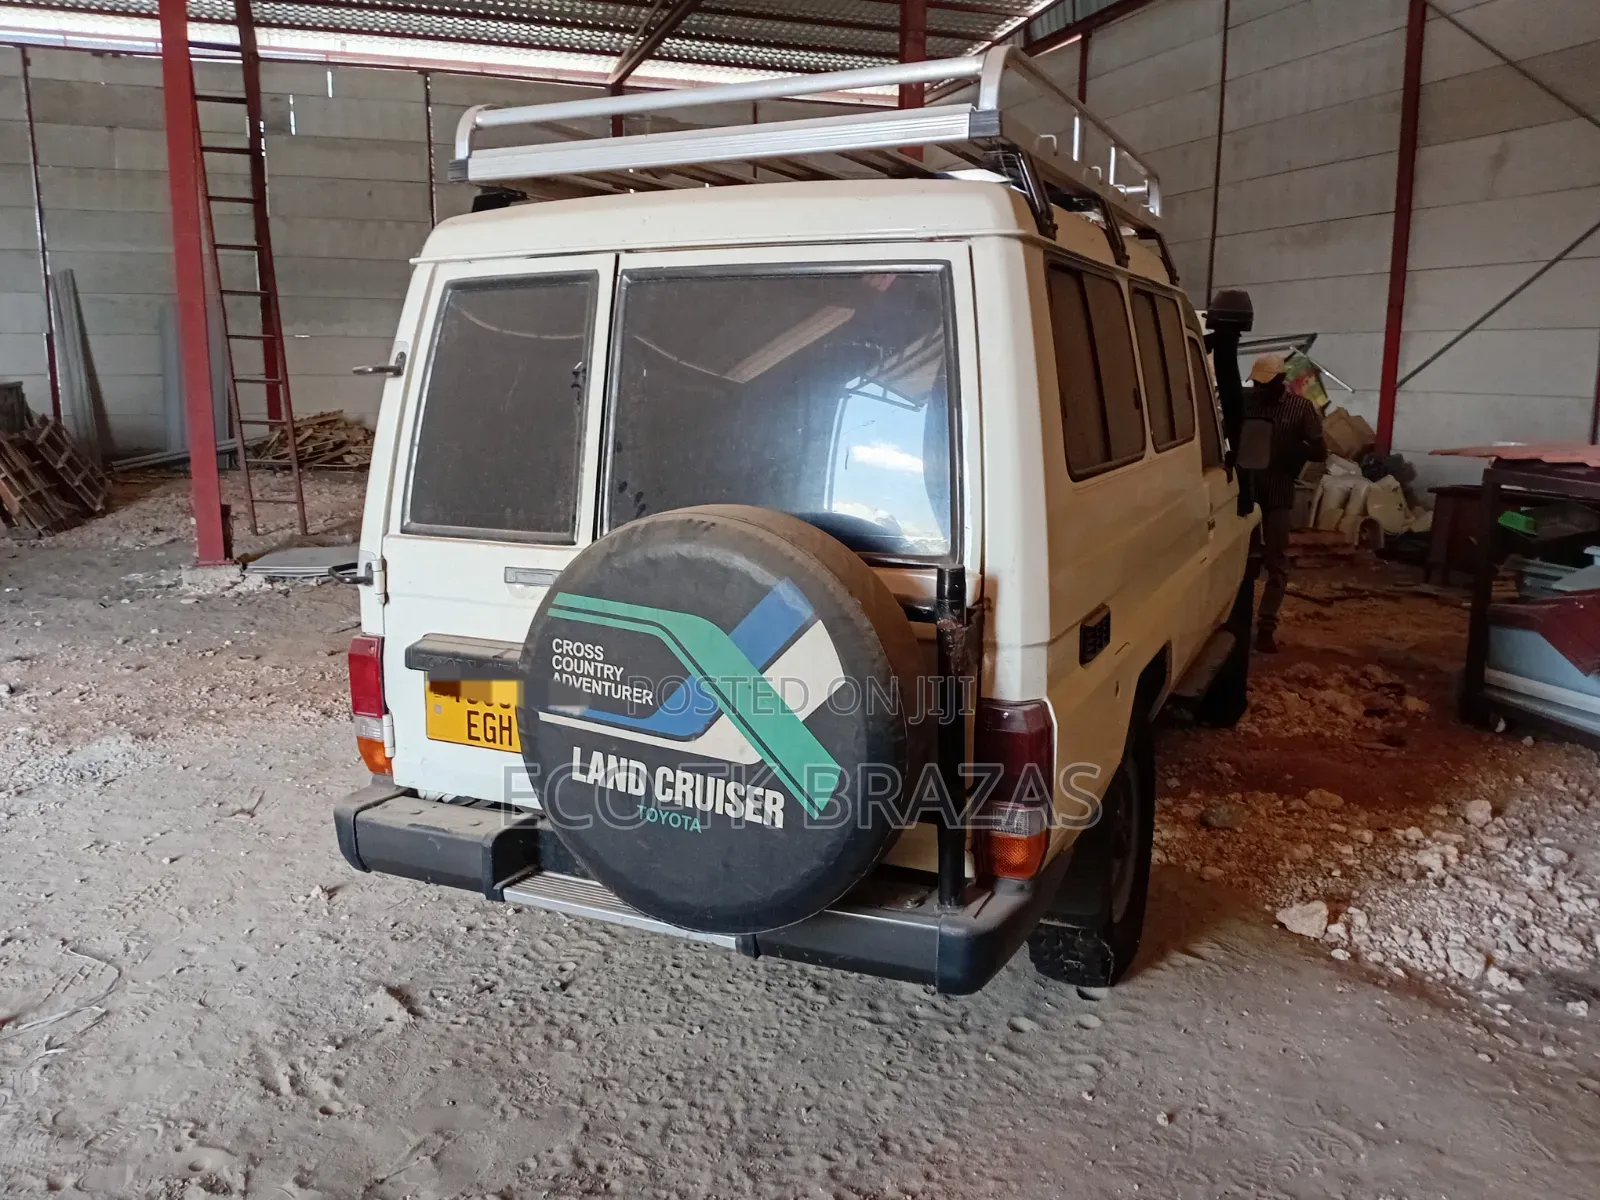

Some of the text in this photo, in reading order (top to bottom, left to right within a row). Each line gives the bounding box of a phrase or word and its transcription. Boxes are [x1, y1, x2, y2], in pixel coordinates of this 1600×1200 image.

[552, 638, 604, 661] CROSS
[552, 655, 624, 681] COUNTRY
[467, 710, 513, 747] EGH
[572, 746, 784, 829] LAND CRUISER
[636, 804, 702, 834] TOYOTA
